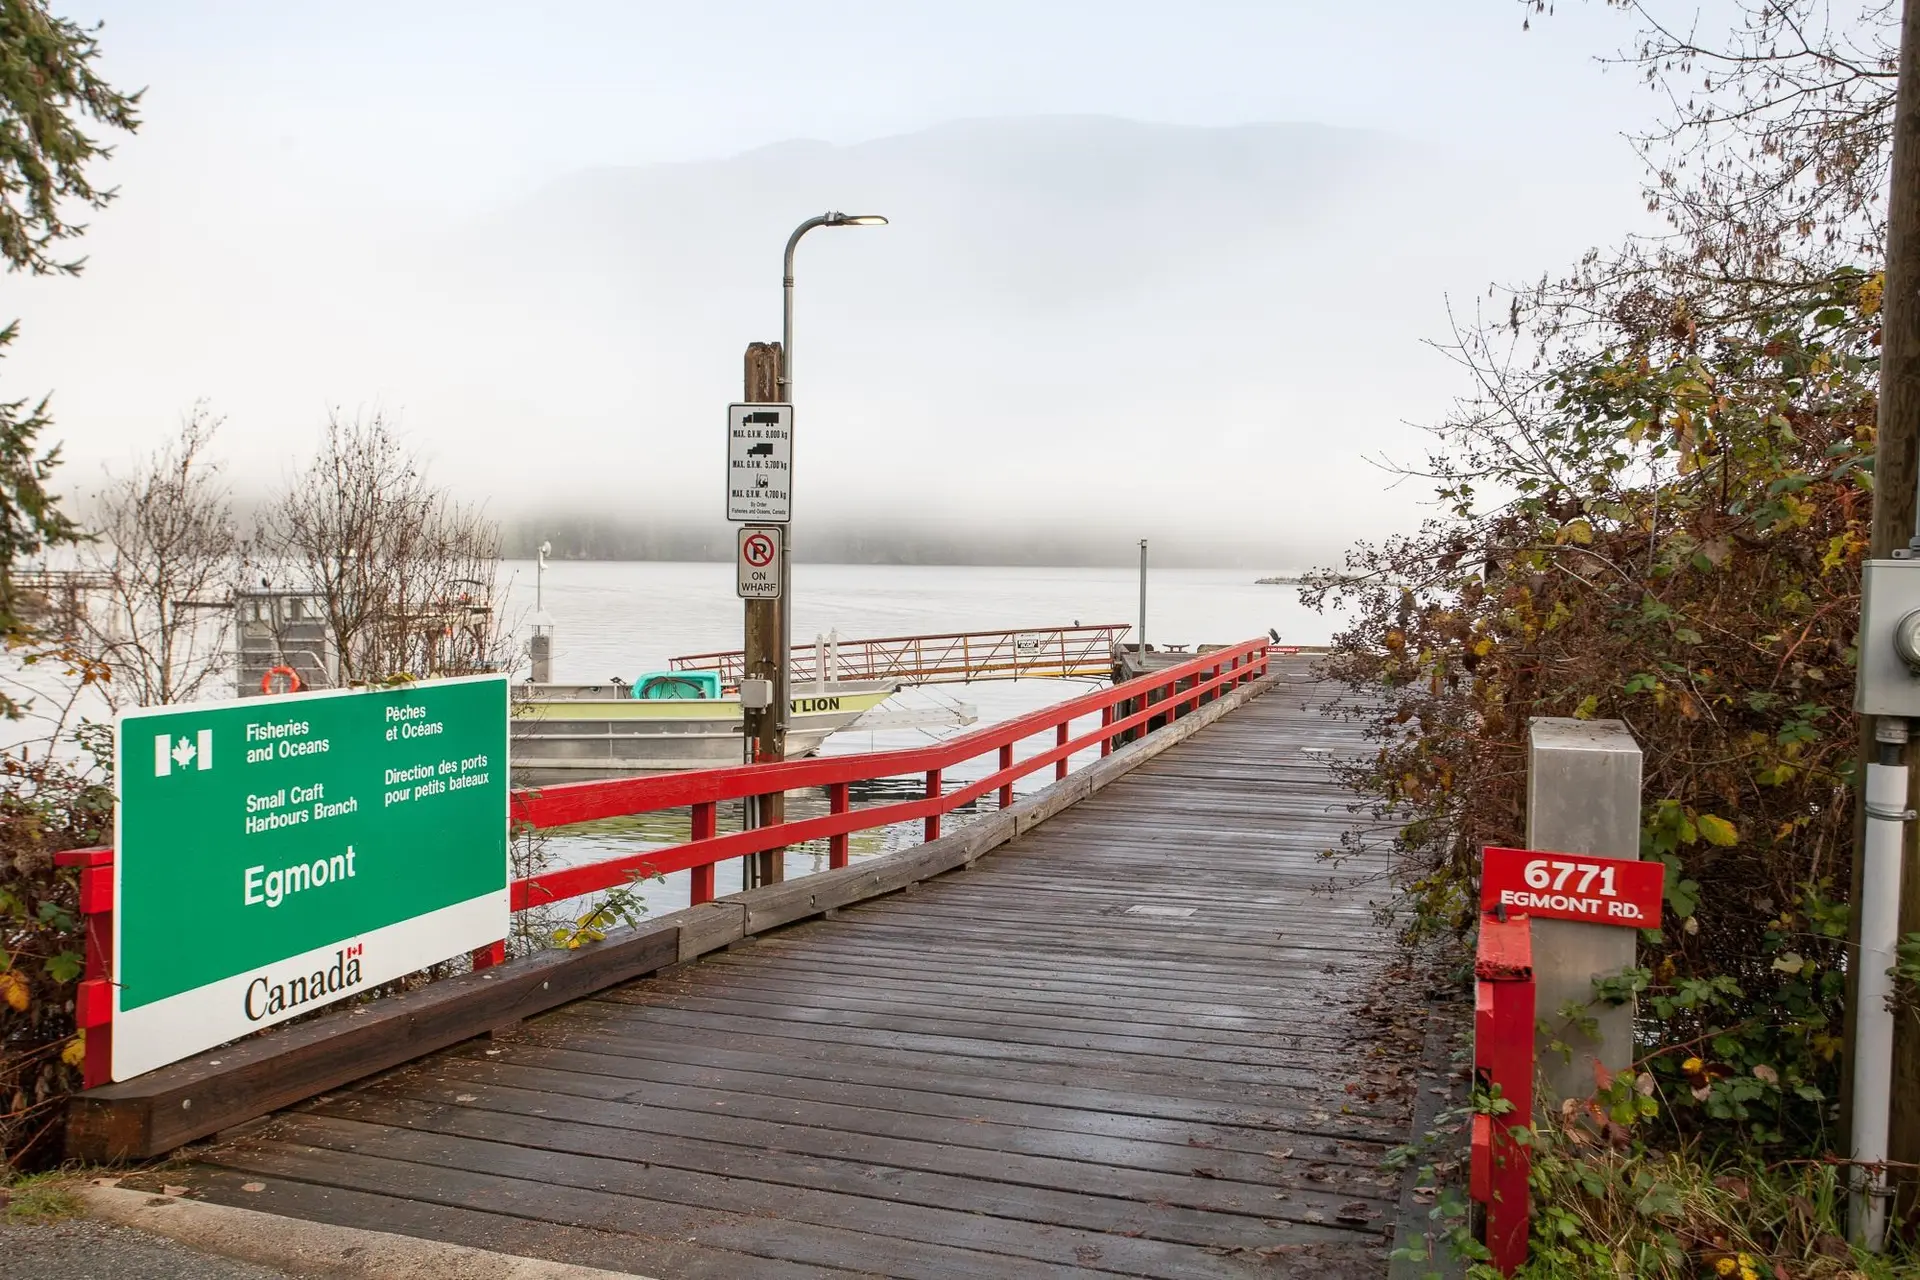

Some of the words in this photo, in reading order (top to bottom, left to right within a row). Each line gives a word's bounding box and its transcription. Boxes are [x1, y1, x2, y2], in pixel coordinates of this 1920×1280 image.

[733, 430, 745, 438] MAX.
[781, 430, 788, 440] kg
[732, 460, 745, 469] MAX.
[780, 461, 787, 470] kg
[732, 489, 744, 498] MAX.
[780, 491, 786, 500] kg
[731, 507, 748, 515] Fisheries
[741, 582, 776, 592] WHARF
[752, 571, 766, 581] ON
[385, 704, 426, 723] Pêches
[802, 697, 840, 712] LION
[246, 719, 309, 743] Fisheries
[385, 726, 399, 741] et
[401, 719, 443, 738] Océans
[246, 744, 273, 764] and
[278, 737, 329, 758] Oceans
[384, 764, 434, 785] Direction
[438, 759, 457, 774] des
[461, 754, 488, 773] ports
[246, 791, 285, 814] Small
[290, 782, 324, 806] Craft
[384, 787, 411, 808] pour
[414, 778, 446, 802] petits
[449, 770, 489, 790] bateaux
[245, 810, 309, 835] Harbours
[314, 796, 358, 818] Branch
[244, 845, 356, 908] Egmont
[1524, 860, 1617, 897] 6771
[1500, 890, 1602, 914] EGMONT
[1608, 901, 1644, 919] RD.
[244, 948, 363, 1021] Canada
